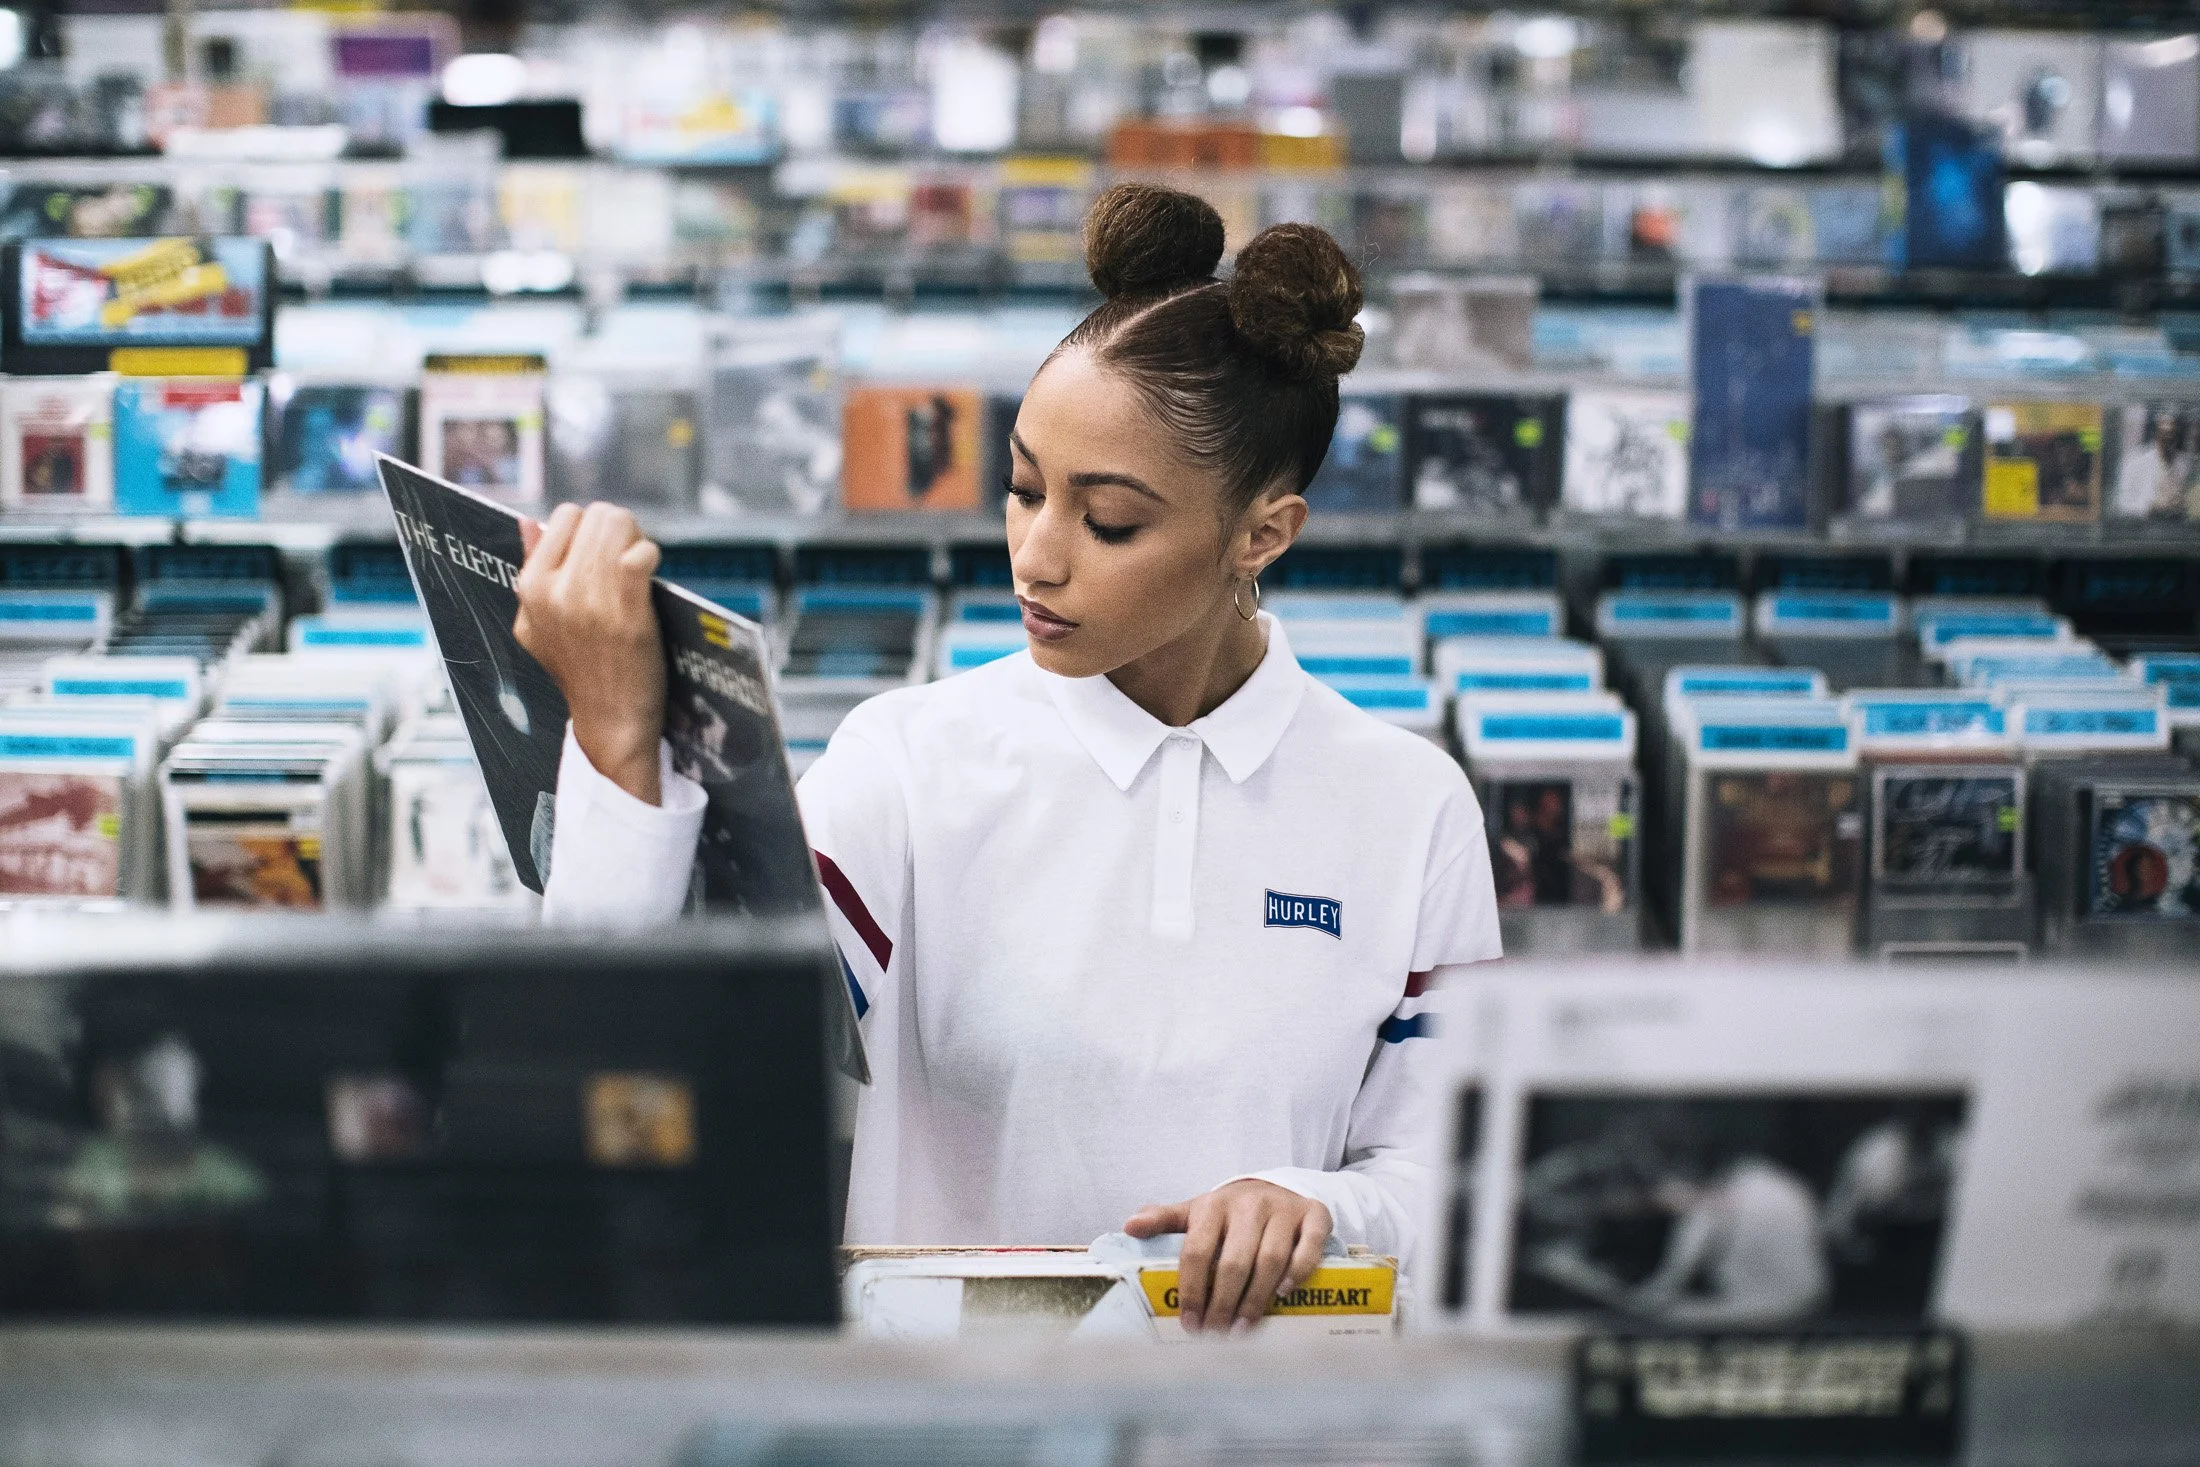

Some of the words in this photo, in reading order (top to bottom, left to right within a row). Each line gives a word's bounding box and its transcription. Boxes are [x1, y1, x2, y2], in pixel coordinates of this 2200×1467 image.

[395, 510, 442, 556] THE
[445, 533, 519, 594] ELECTR
[1268, 896, 1339, 929] HURLEY
